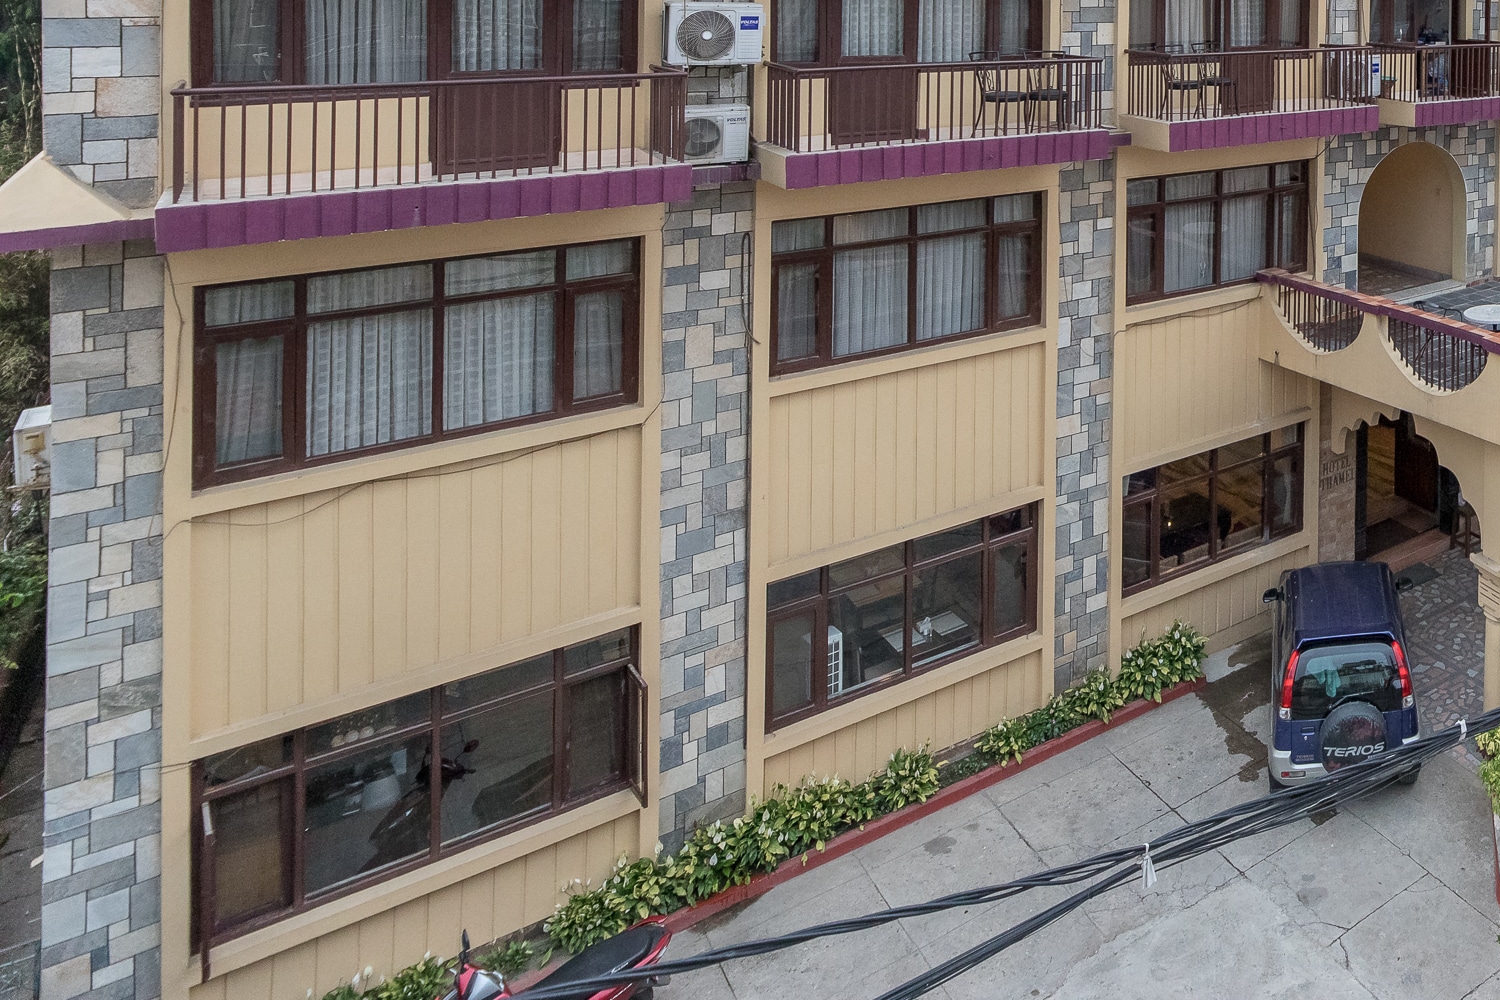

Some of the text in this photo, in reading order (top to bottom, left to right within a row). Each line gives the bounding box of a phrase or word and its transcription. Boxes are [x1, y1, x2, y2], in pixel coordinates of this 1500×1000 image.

[1322, 455, 1352, 477] HOTEL
[1320, 468, 1356, 491] THAMEL
[1323, 741, 1385, 757] TERIOS
